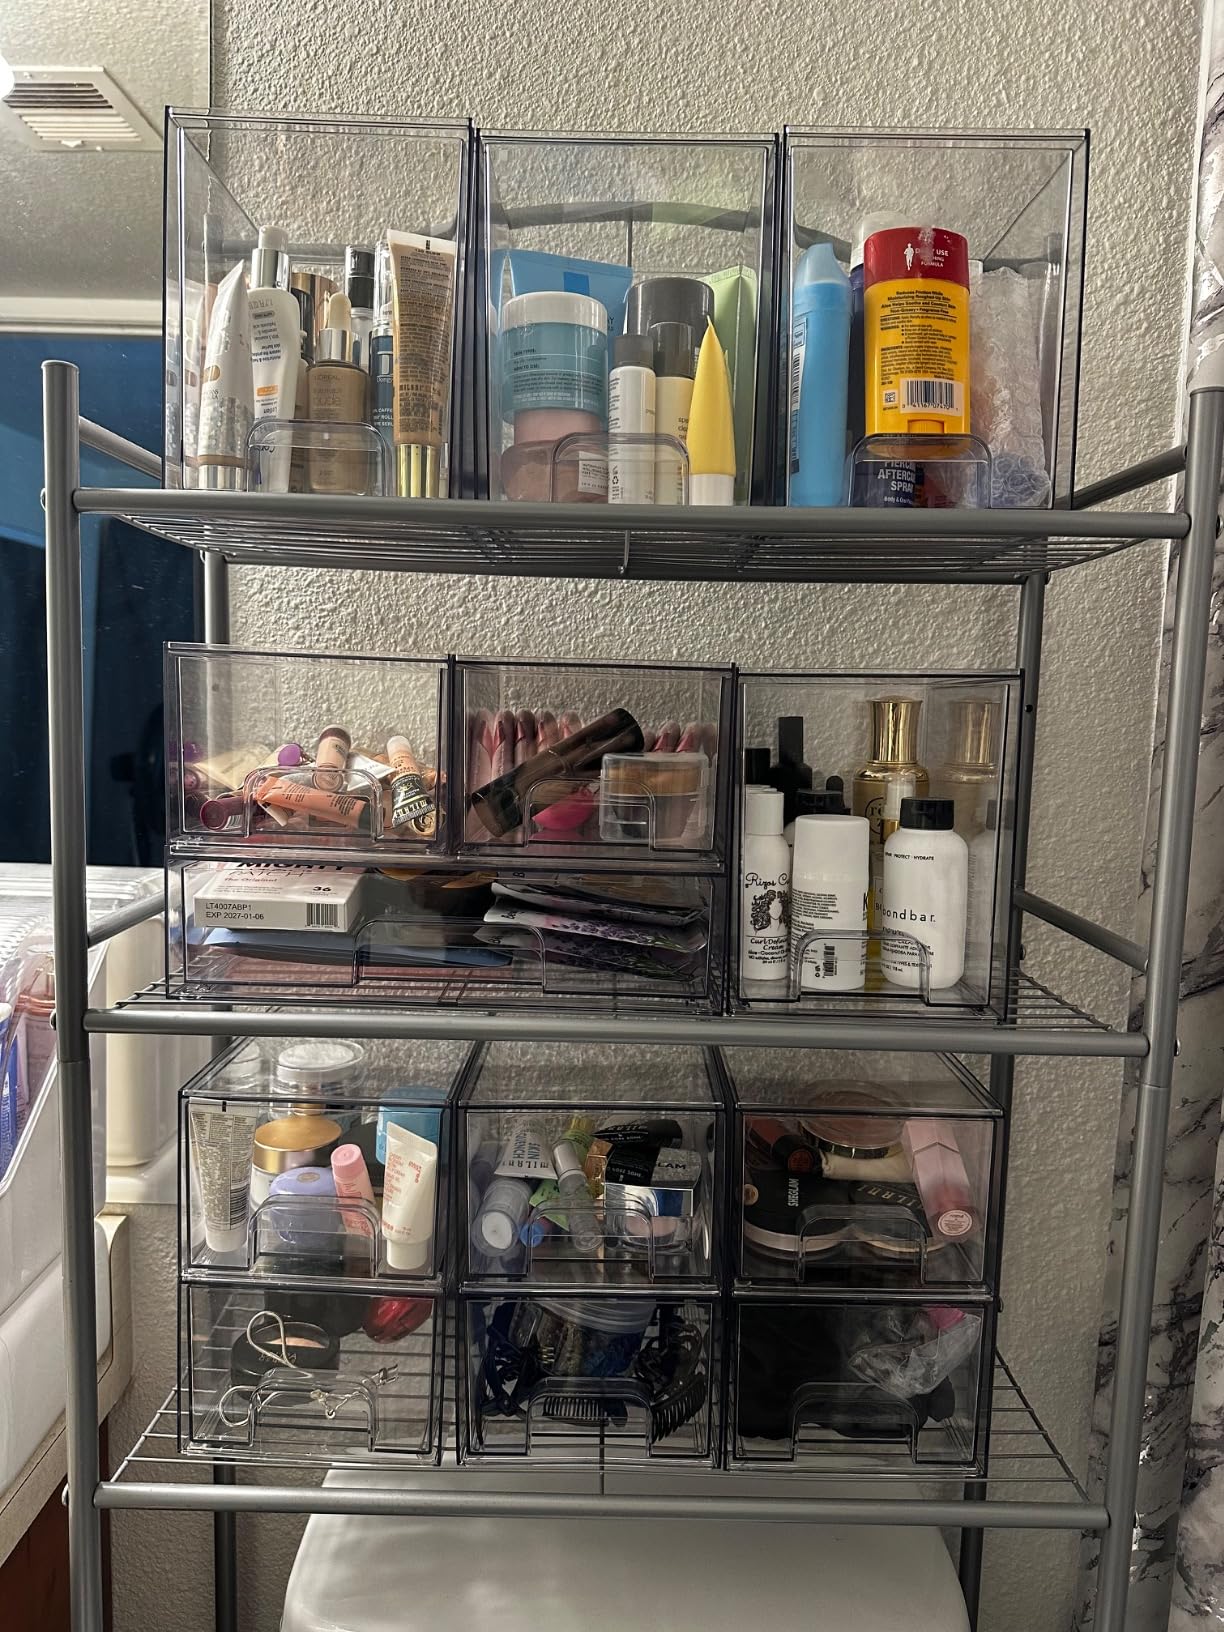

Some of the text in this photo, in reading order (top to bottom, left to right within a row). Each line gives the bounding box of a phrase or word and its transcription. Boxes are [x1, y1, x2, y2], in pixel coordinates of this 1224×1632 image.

[936, 249, 949, 257] USE
[205, 911, 264, 920] EXP 2027-01-06
[787, 1178, 800, 1207] SHEGLAM
